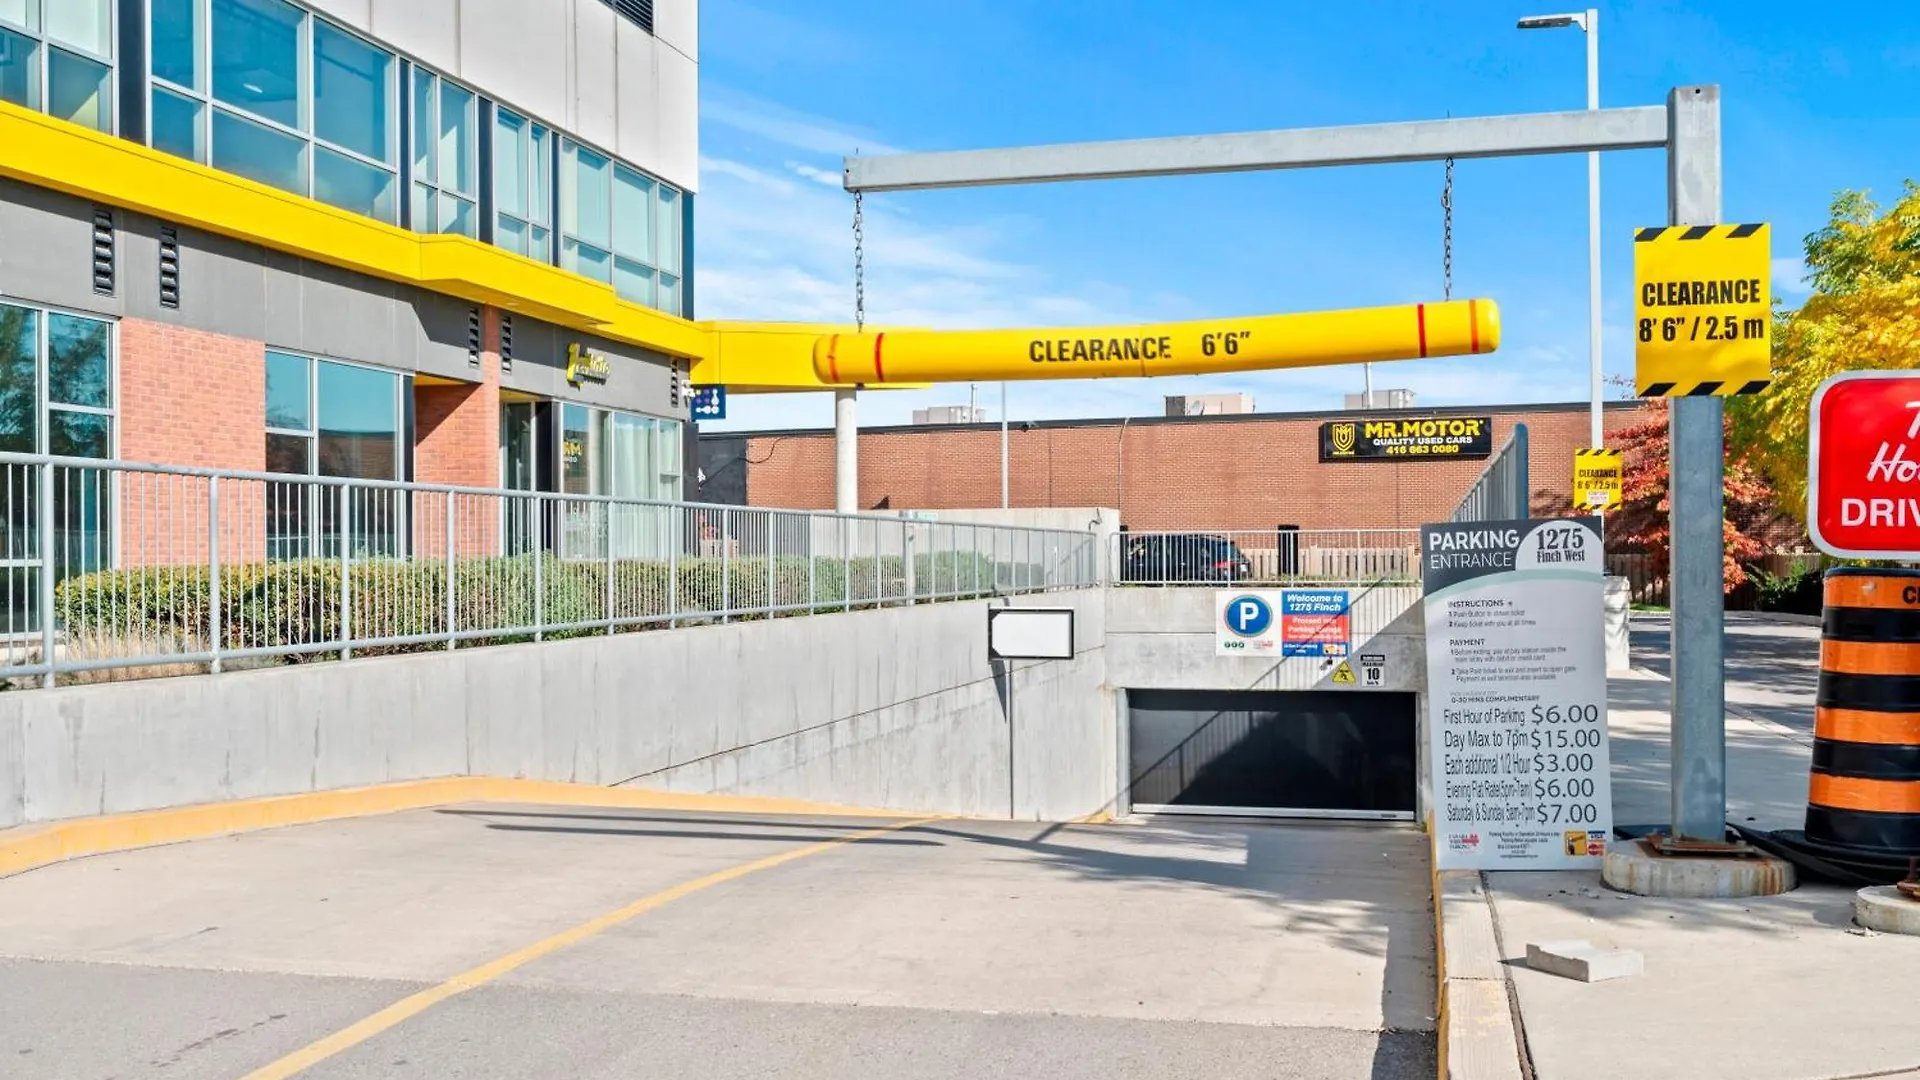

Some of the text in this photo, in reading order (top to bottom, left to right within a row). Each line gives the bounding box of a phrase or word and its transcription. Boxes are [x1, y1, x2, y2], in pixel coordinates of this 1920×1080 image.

[1642, 279, 1760, 306] CLEARANCE
[1639, 318, 1657, 342] 8'
[1690, 316, 1700, 341] /
[1706, 316, 1738, 340] 2.5
[1744, 318, 1764, 339] m
[1029, 337, 1171, 362] CLEARANCE
[1365, 420, 1480, 438] MR.MOTOR
[1373, 437, 1415, 445] QUALITY
[1446, 436, 1473, 444] CARS
[1386, 446, 1407, 454] 416
[1578, 469, 1617, 477] CLEARANCE
[1429, 529, 1520, 551] PARKING
[1536, 528, 1584, 550] 1275
[1430, 552, 1513, 570] ENTRANCE
[1536, 549, 1585, 563] Finch West
[1287, 594, 1343, 602] Welcome to
[1290, 603, 1341, 611] 1275 Finch
[1448, 600, 1504, 608] INSTRUCTIONS
[1240, 602, 1259, 630] P
[1450, 638, 1485, 646] PAYMENT
[1366, 668, 1380, 680] 10
[1444, 704, 1598, 727] First Hour of Parking $6.00
[1444, 729, 1600, 751] Day Max to 7pm $15.00
[1445, 753, 1463, 774] Each
[1465, 752, 1498, 774] additional
[1512, 752, 1531, 774] Hour
[1534, 753, 1593, 774] $3.00
[1446, 780, 1471, 803] Evening
[1472, 780, 1484, 797] Flat
[1535, 778, 1594, 799] $6.00
[1446, 803, 1474, 825] Saturday
[1475, 803, 1481, 821] &
[1482, 803, 1505, 824] Sunday
[1537, 804, 1597, 825] $7.00
